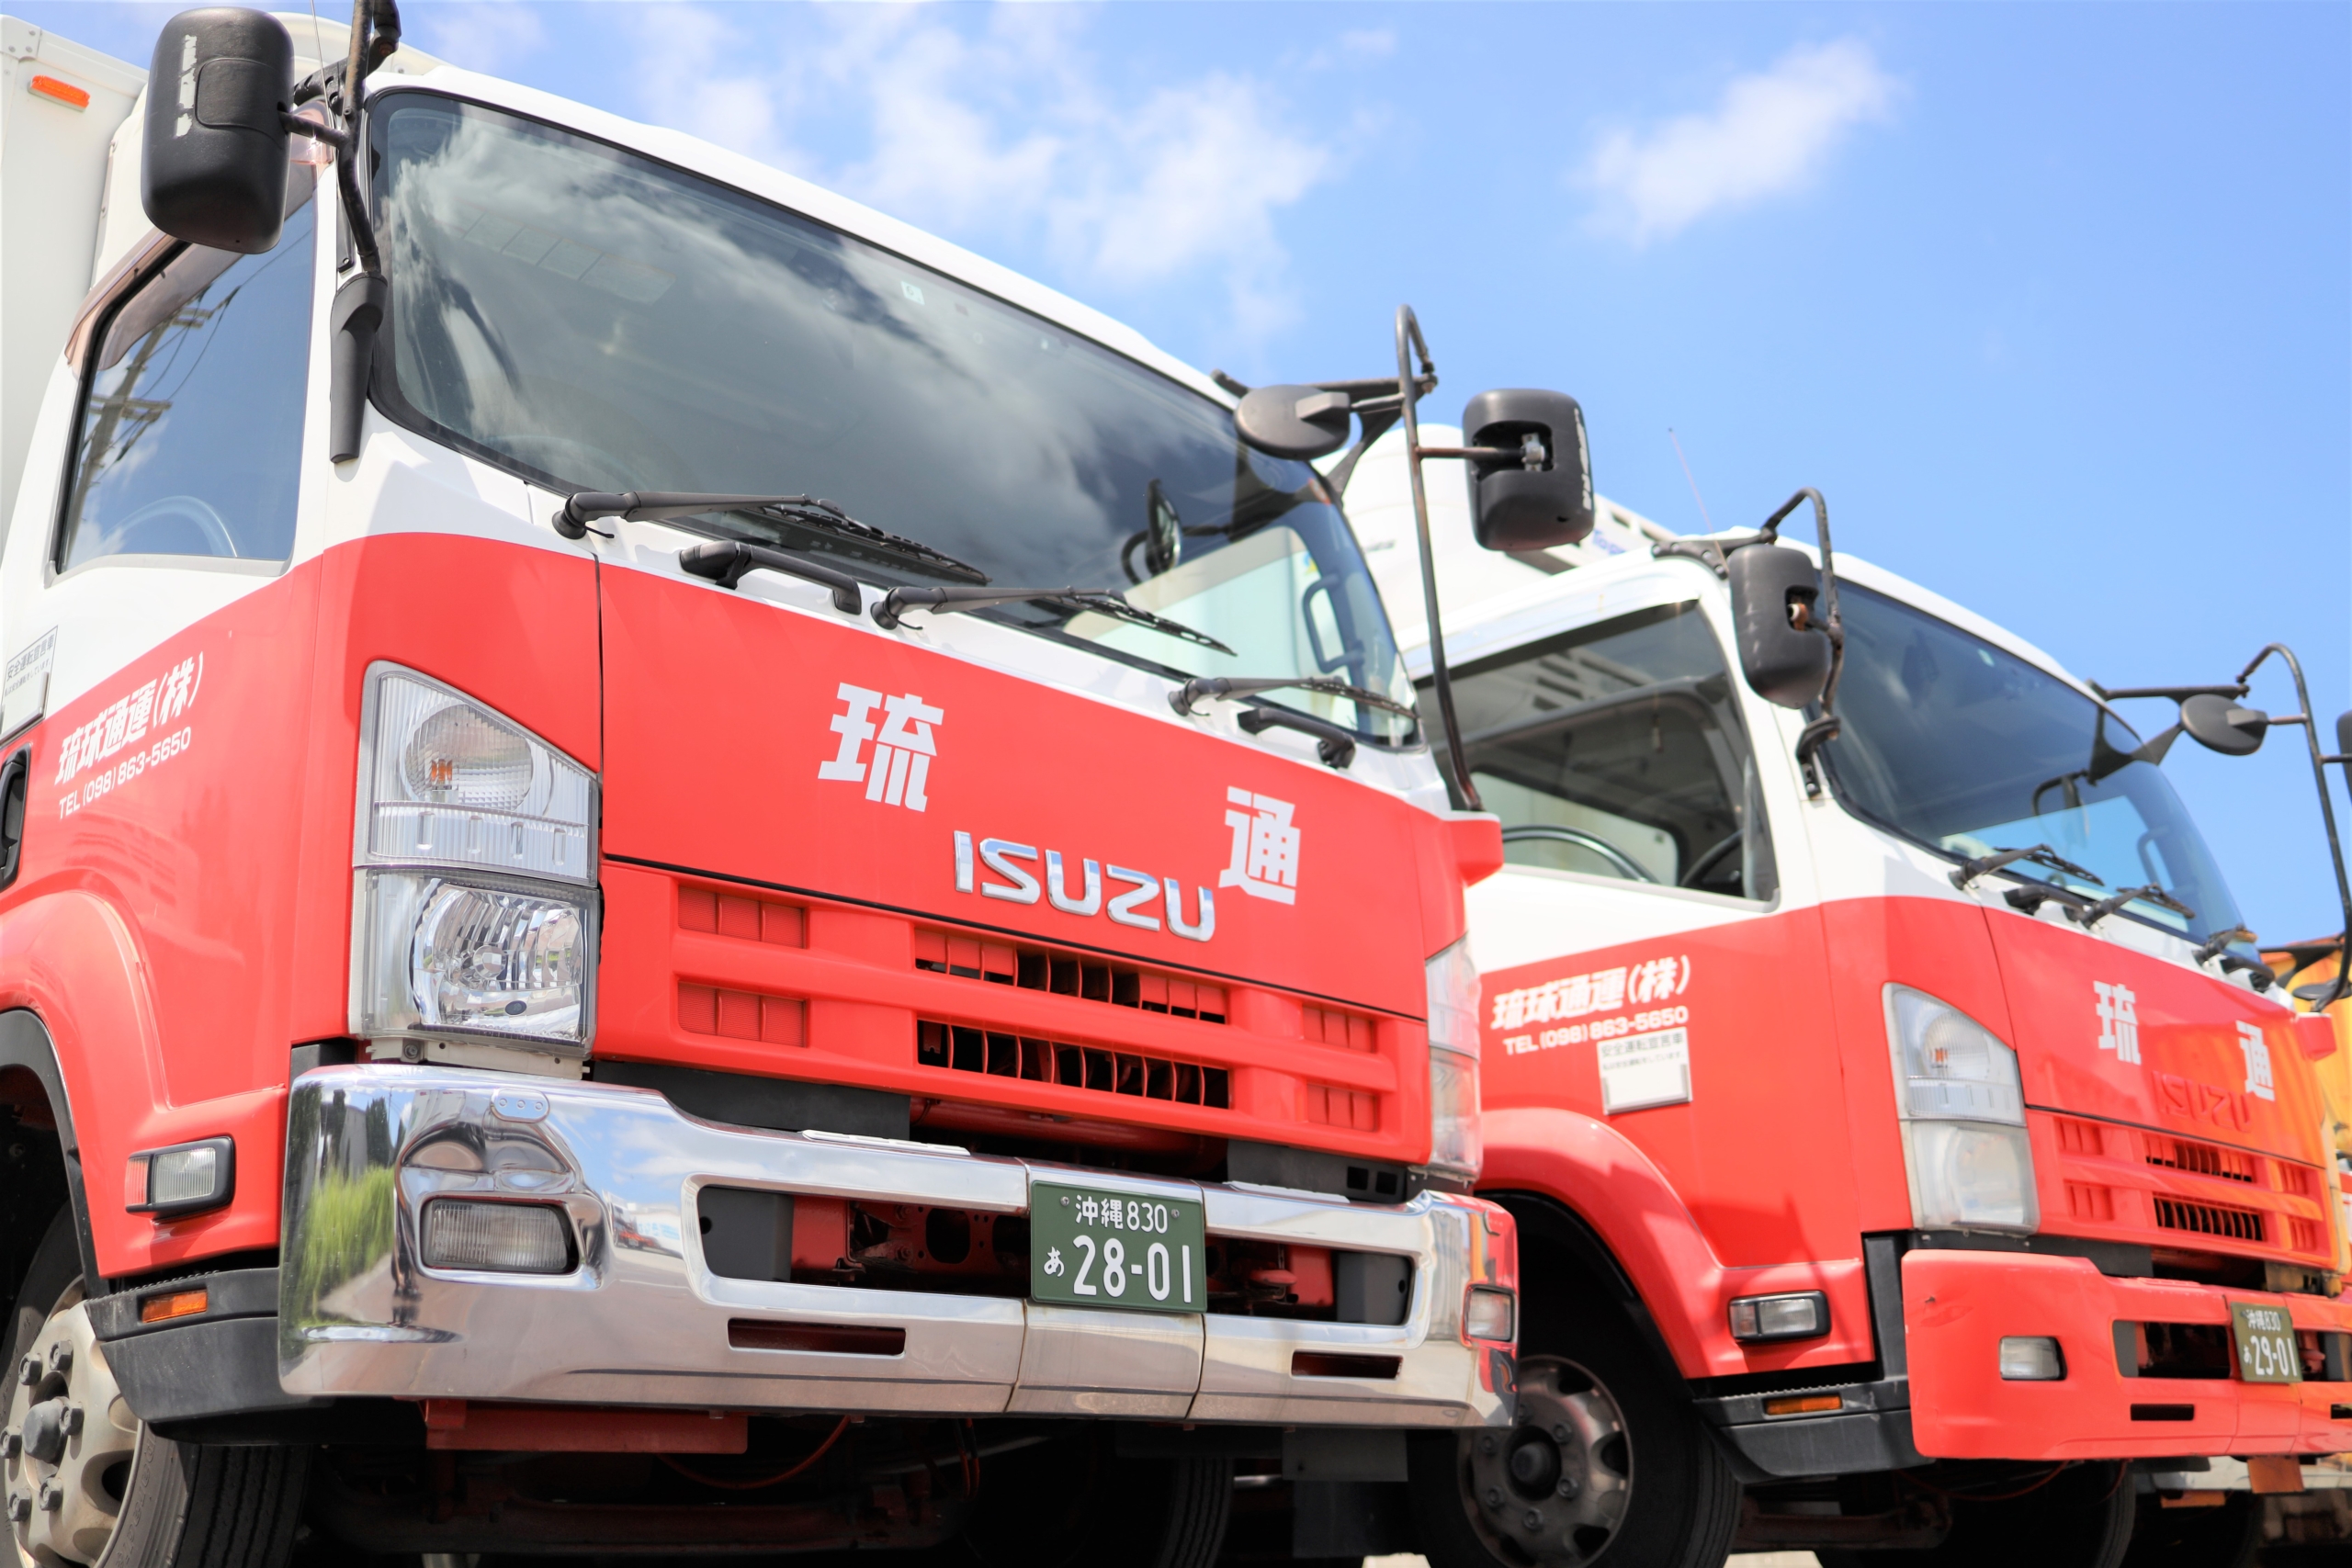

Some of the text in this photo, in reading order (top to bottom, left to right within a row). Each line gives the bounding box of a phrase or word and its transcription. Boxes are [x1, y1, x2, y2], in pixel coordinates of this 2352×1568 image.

[54, 650, 204, 785] 琉球通運(株)
[59, 790, 81, 819] TEL
[953, 829, 1216, 942] ISUZU
[1503, 1034, 1539, 1055] TEL
[2152, 1070, 2252, 1134] ISUZU
[1075, 1194, 1168, 1234] 沖縄830
[1044, 1235, 1192, 1303] あ 28-01
[2250, 1335, 2298, 1377] 29-01
